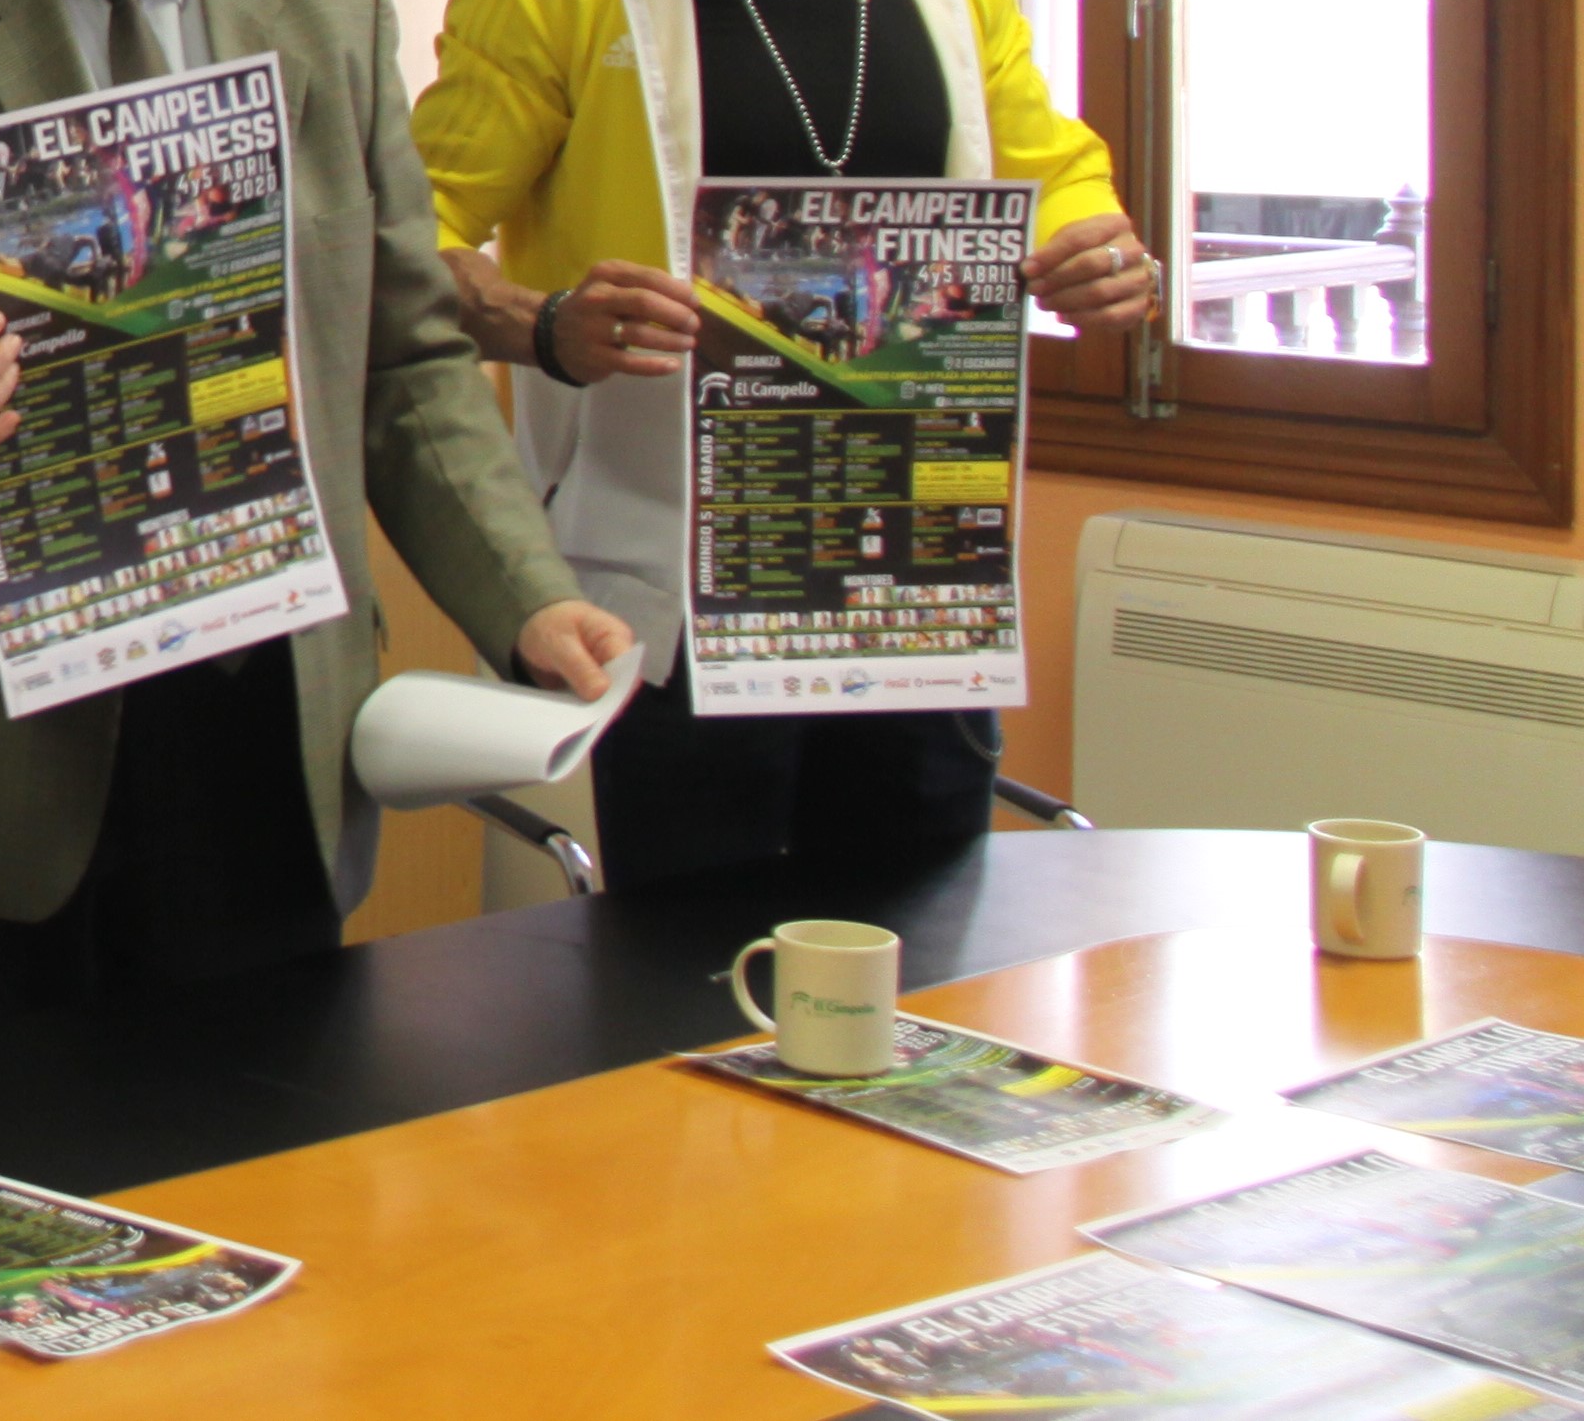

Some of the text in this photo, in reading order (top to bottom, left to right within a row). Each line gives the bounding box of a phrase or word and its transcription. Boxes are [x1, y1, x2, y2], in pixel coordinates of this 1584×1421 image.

[34, 70, 272, 160] EL CAMPELLO
[126, 112, 276, 183] FITNESS
[221, 153, 276, 184] ABRIL
[232, 175, 278, 204] 2020
[801, 191, 1027, 225] EL CAMPELLO
[877, 228, 1022, 262] FITNESS
[962, 265, 1016, 284] ABRIL
[971, 284, 1016, 303] 2020
[734, 382, 818, 400] El Campello
[700, 511, 713, 594] DOMINGO 5
[1356, 1023, 1536, 1083] EL CAMPELLO
[900, 1313, 975, 1344] EL
